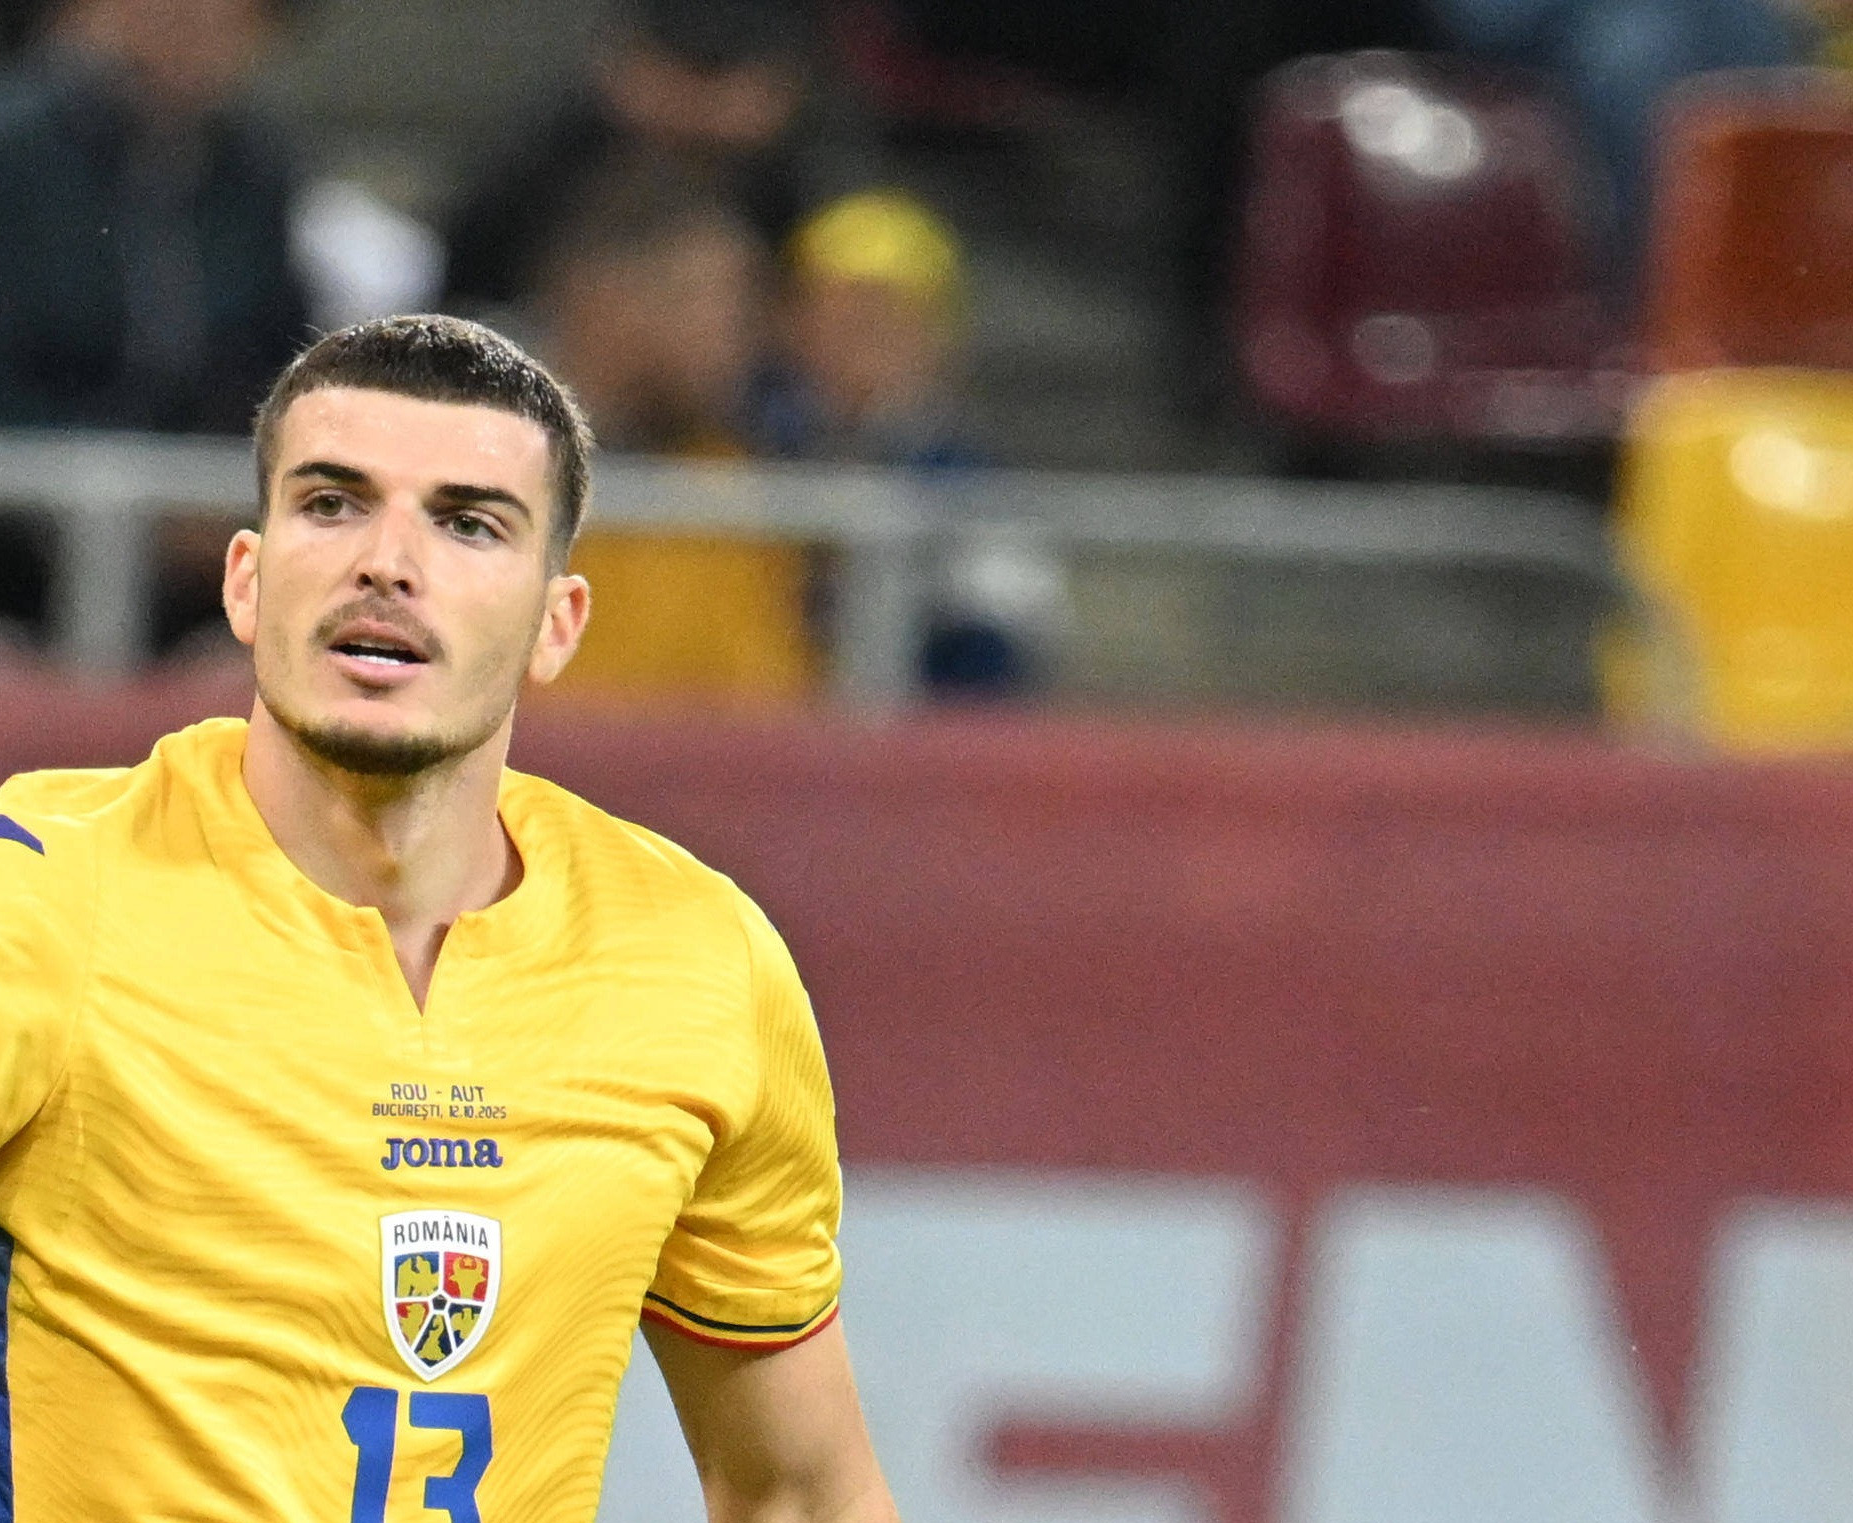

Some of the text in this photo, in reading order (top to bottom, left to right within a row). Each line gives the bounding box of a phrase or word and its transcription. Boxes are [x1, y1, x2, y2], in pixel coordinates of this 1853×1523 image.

[390, 1083, 427, 1101] ROU
[451, 1084, 484, 1103] AUT
[394, 1215, 490, 1249] ROMÂNIA
